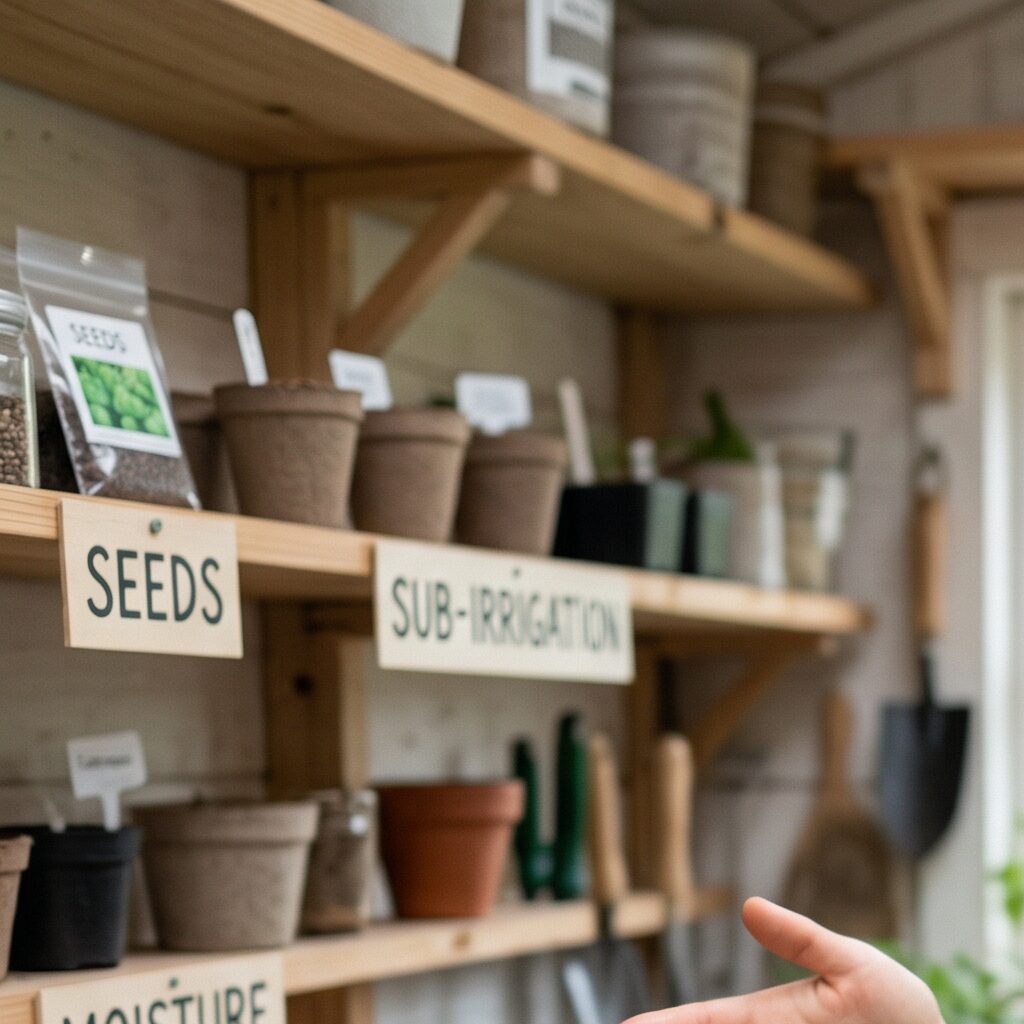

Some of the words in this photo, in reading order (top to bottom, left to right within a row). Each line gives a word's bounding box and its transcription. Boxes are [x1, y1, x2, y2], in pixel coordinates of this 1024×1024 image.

[70, 322, 127, 353] SEEDS
[87, 545, 223, 625] SEEDS
[392, 576, 620, 652] SUB-IRRIGATION
